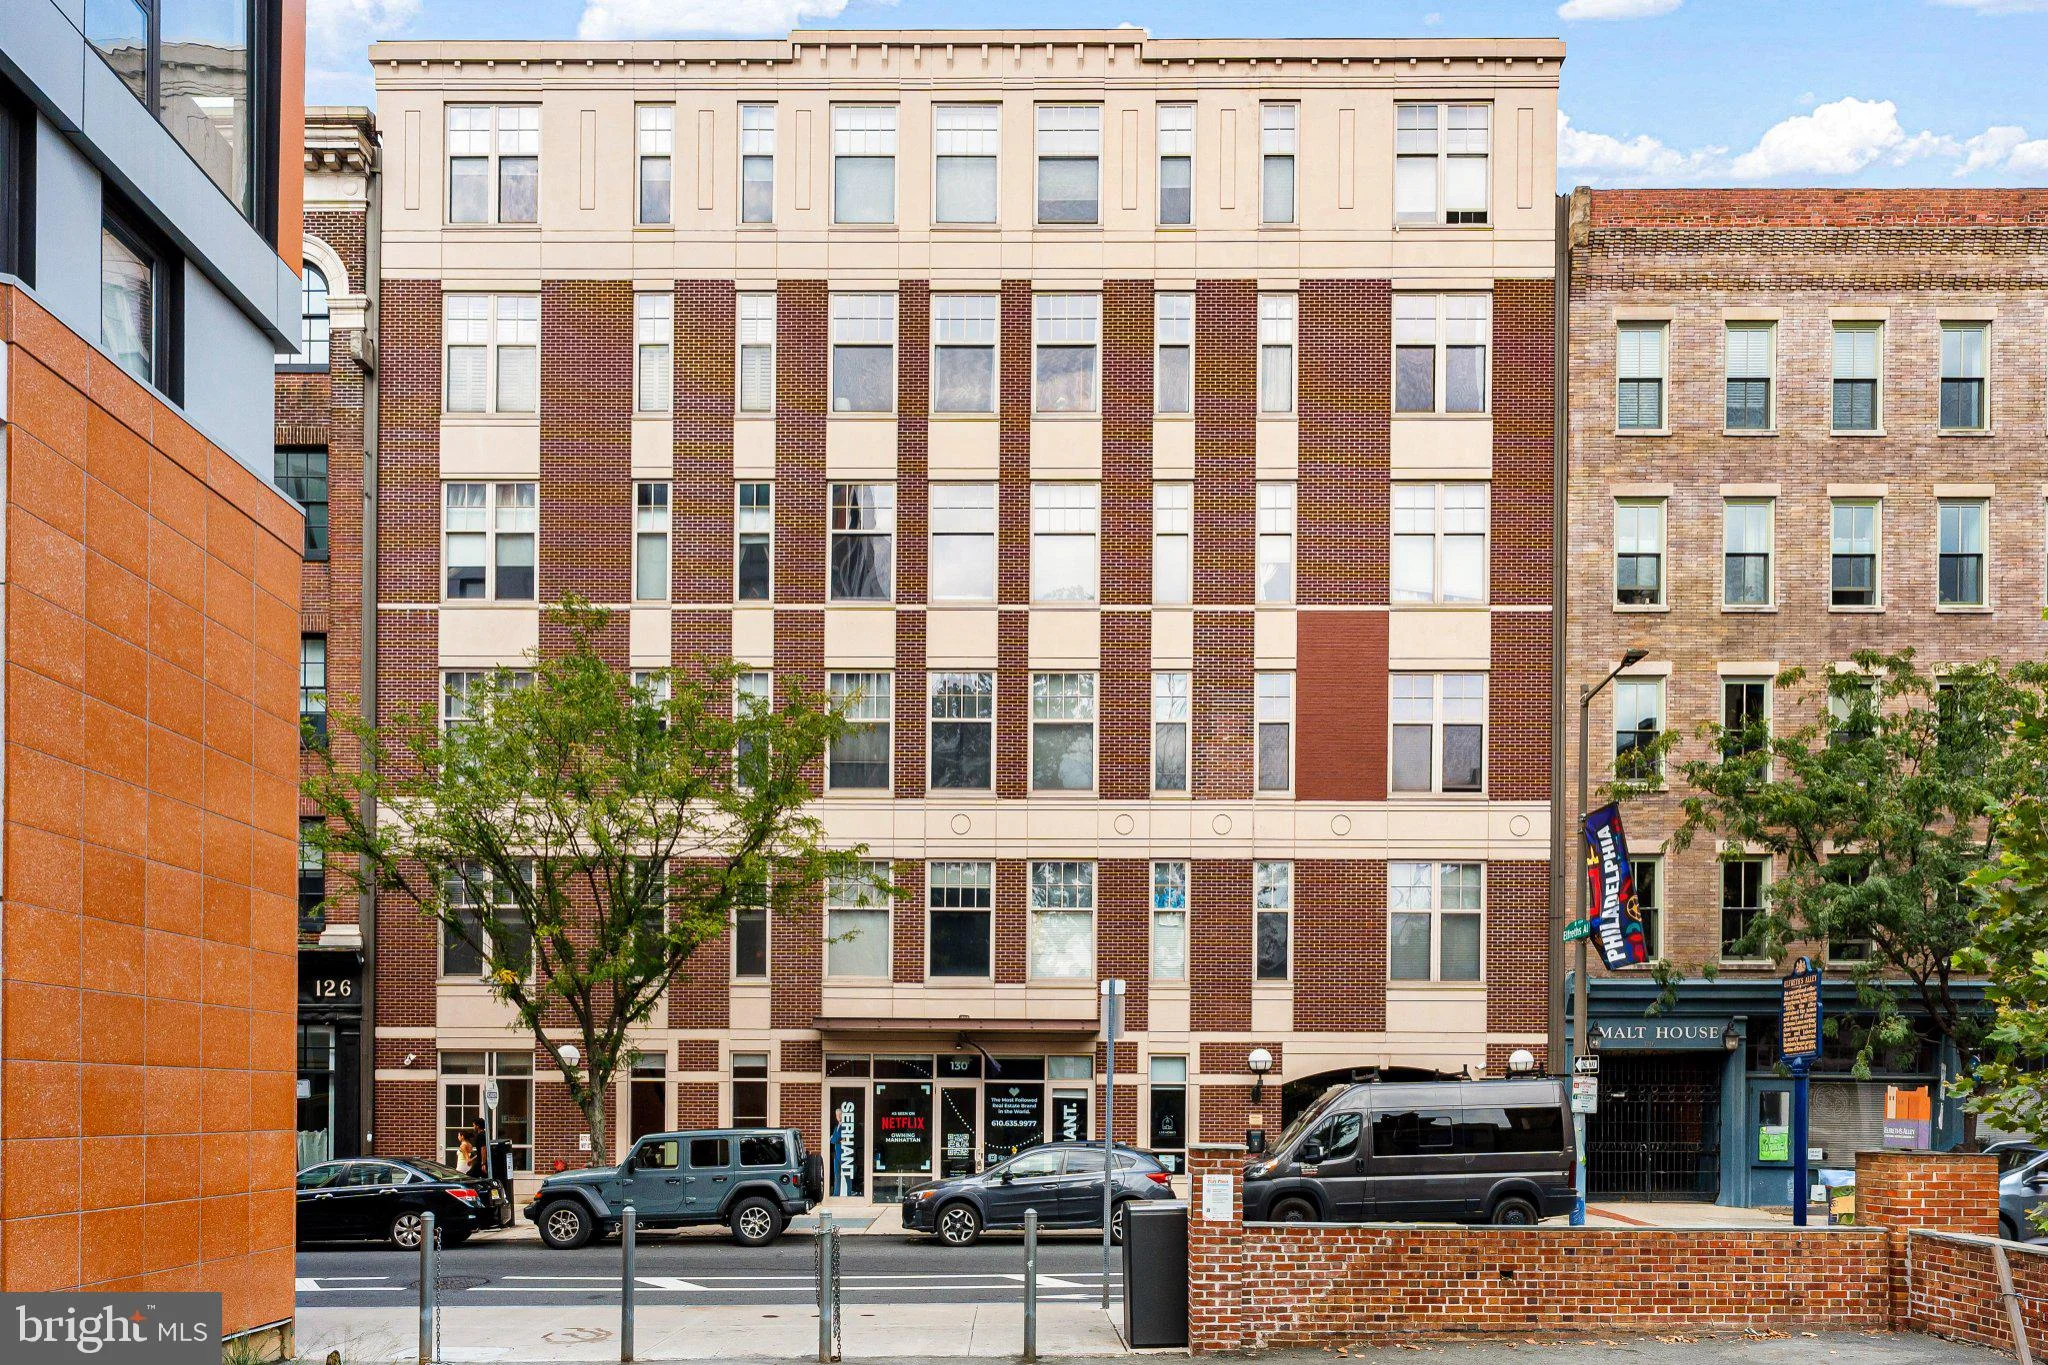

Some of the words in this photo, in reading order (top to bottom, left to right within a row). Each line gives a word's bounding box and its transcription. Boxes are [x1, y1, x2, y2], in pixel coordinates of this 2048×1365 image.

[1597, 824, 1626, 964] PHILADELPHIA
[316, 979, 351, 996] 126
[1599, 1026, 1647, 1039] MALT
[1655, 1026, 1720, 1039] HOUSE
[950, 1061, 968, 1070] 130
[881, 1117, 925, 1130] NETFLIX
